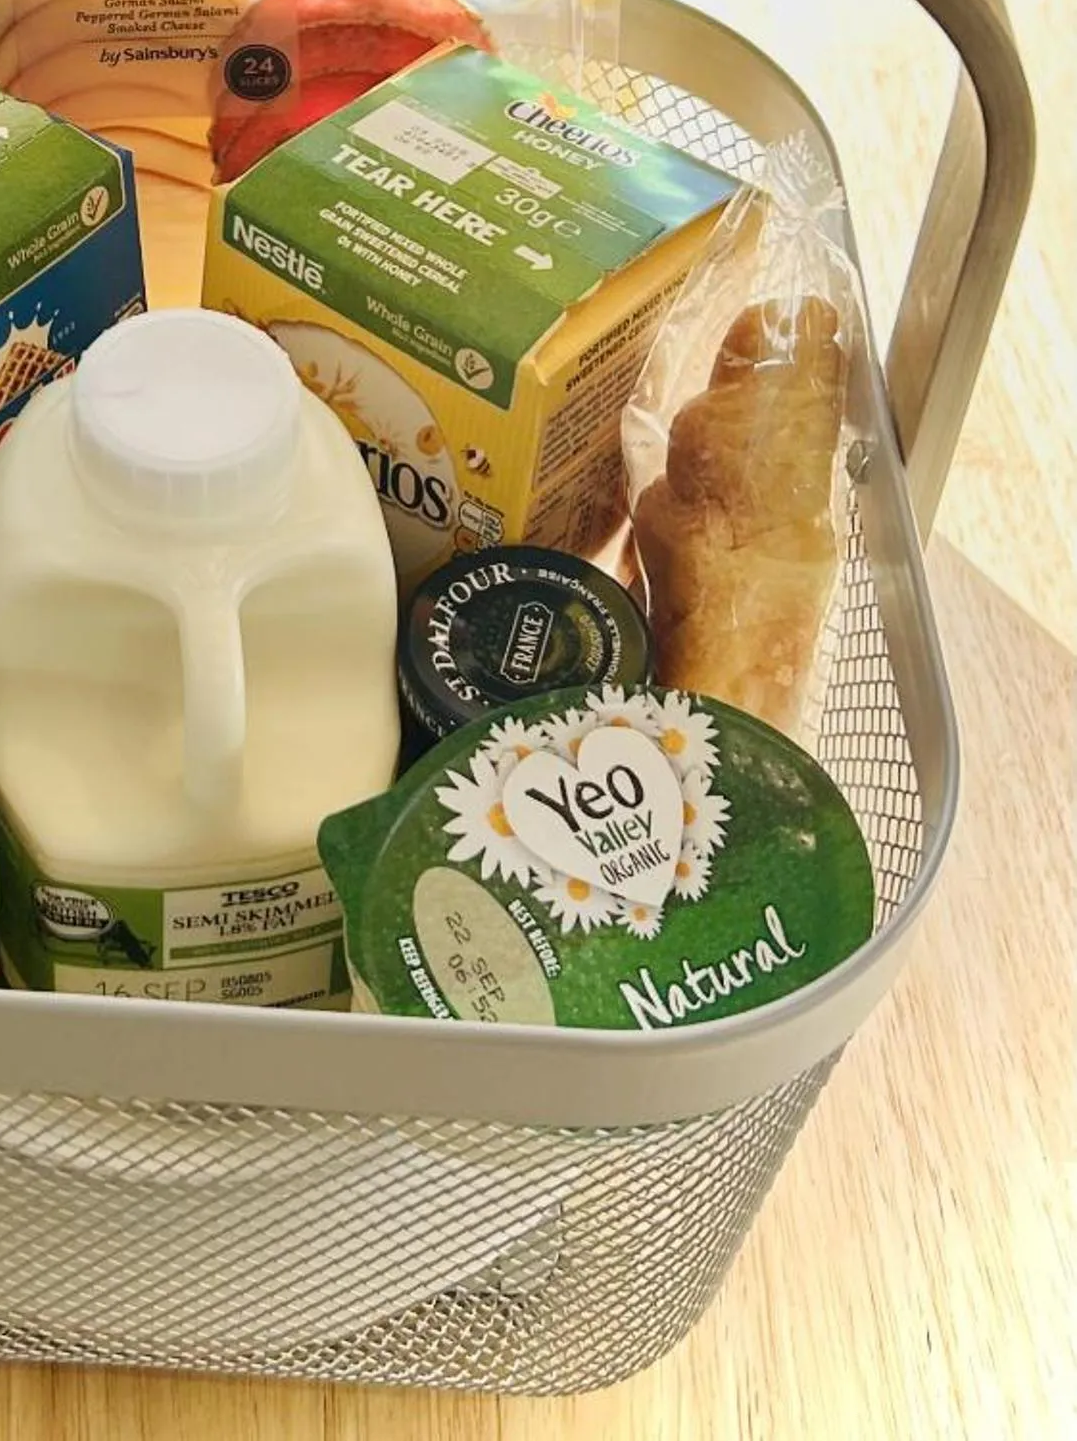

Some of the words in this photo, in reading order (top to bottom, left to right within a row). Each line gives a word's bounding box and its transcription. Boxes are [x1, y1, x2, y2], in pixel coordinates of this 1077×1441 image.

[75, 10, 135, 24] Peppered
[138, 8, 190, 21] German
[193, 6, 239, 18] Salami
[107, 21, 158, 34] Smoked
[160, 20, 205, 32] Cheese
[99, 46, 121, 65] by
[123, 45, 219, 63] Sainsbury's
[243, 58, 274, 75] 24
[506, 100, 639, 167] Cheerios
[512, 131, 606, 171] HONEY
[331, 144, 416, 199] TEAR
[412, 189, 509, 247] HERE
[495, 188, 557, 228] 30g
[7, 237, 47, 270] Whole
[46, 212, 80, 240] Grain
[334, 201, 392, 236] FORTIFIED
[426, 250, 468, 280] WHOLE
[233, 215, 325, 291] Nestlé
[366, 295, 411, 333] Whole
[413, 325, 453, 358] Grain
[352, 242, 383, 266] WITH
[380, 260, 422, 287] HONEY
[355, 439, 448, 523] rios
[427, 562, 516, 674] DALFOUR
[511, 615, 544, 672] FRANCE
[444, 675, 481, 702] ST
[525, 764, 646, 835] Yeo
[574, 809, 654, 860] Valley
[599, 840, 671, 887] ORGANIC
[221, 881, 301, 907] TESCO
[507, 899, 537, 931] BEST
[172, 912, 230, 930] SEMI
[398, 936, 423, 968] KEEP
[444, 910, 472, 946] 22
[471, 957, 507, 1004] SEP
[620, 904, 807, 1030] Natural
[143, 978, 208, 1002] SEP
[410, 966, 459, 1022] REFRIGER
